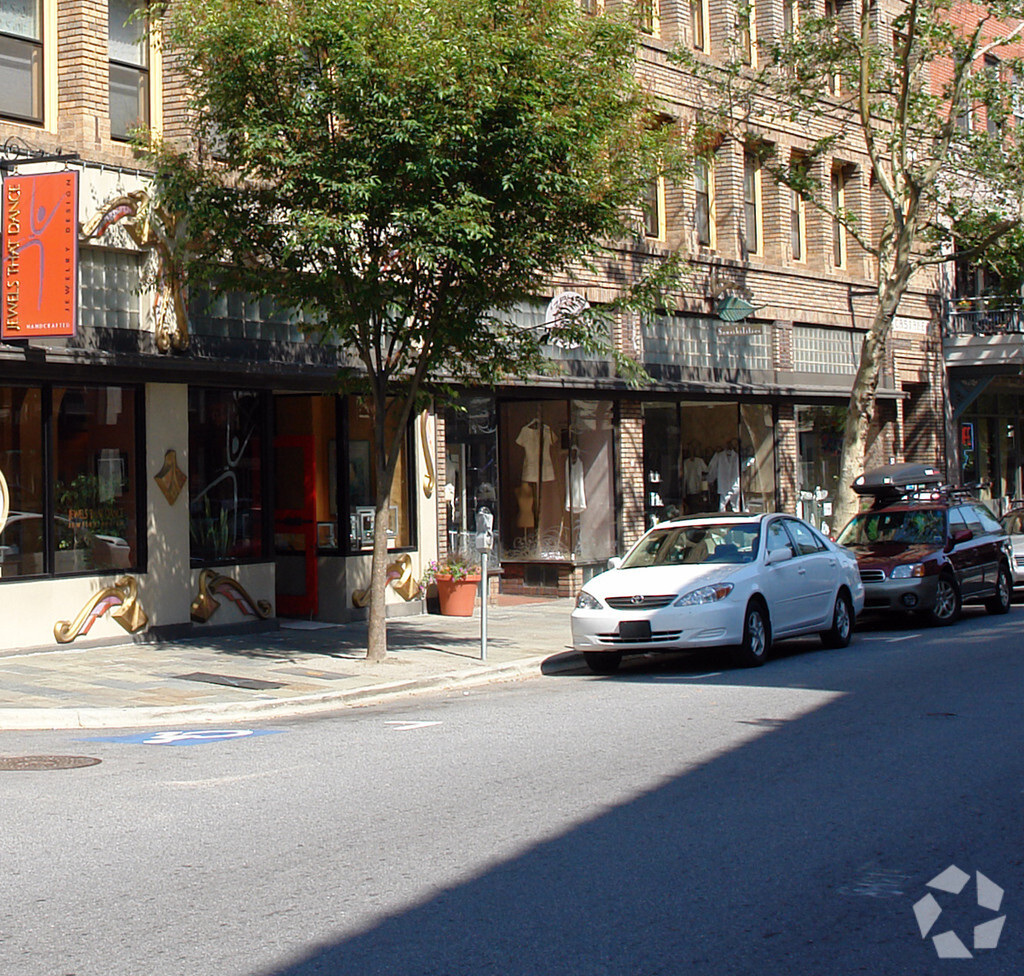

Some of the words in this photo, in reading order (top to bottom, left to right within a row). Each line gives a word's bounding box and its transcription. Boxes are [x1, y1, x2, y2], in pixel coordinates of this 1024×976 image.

[7, 184, 21, 235] DANCE
[7, 239, 20, 276] THAT
[6, 280, 20, 331] JEWELS
[25, 322, 71, 330] HANDCRAFTED
